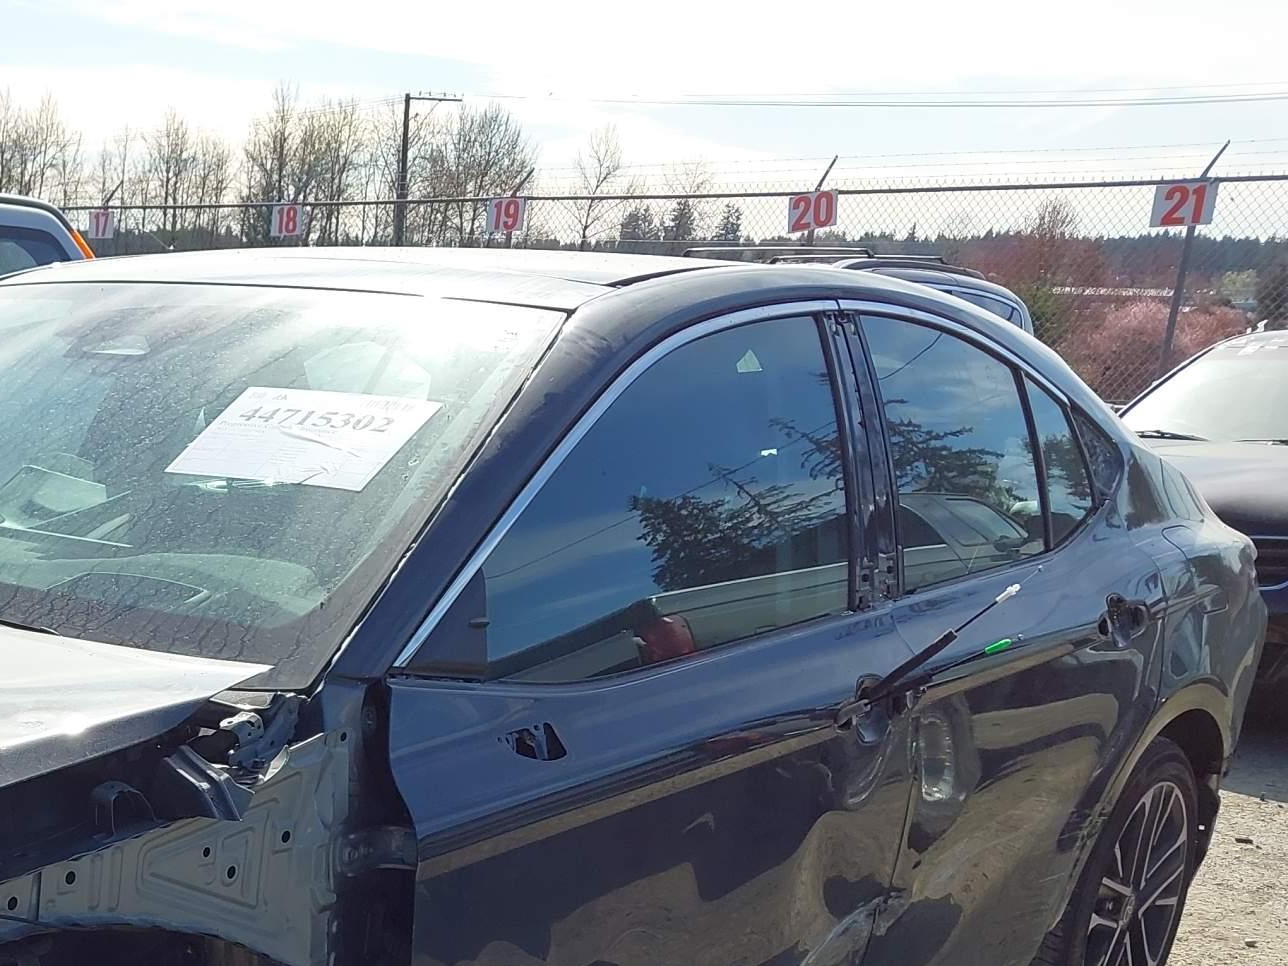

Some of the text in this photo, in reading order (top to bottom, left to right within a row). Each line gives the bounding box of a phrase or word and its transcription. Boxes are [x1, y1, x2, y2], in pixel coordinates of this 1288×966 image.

[277, 206, 298, 234] 18
[493, 199, 520, 231] 19
[791, 191, 834, 232] 20
[1159, 184, 1208, 226] 21
[94, 212, 110, 238] 17
[238, 406, 395, 433] 44715302
